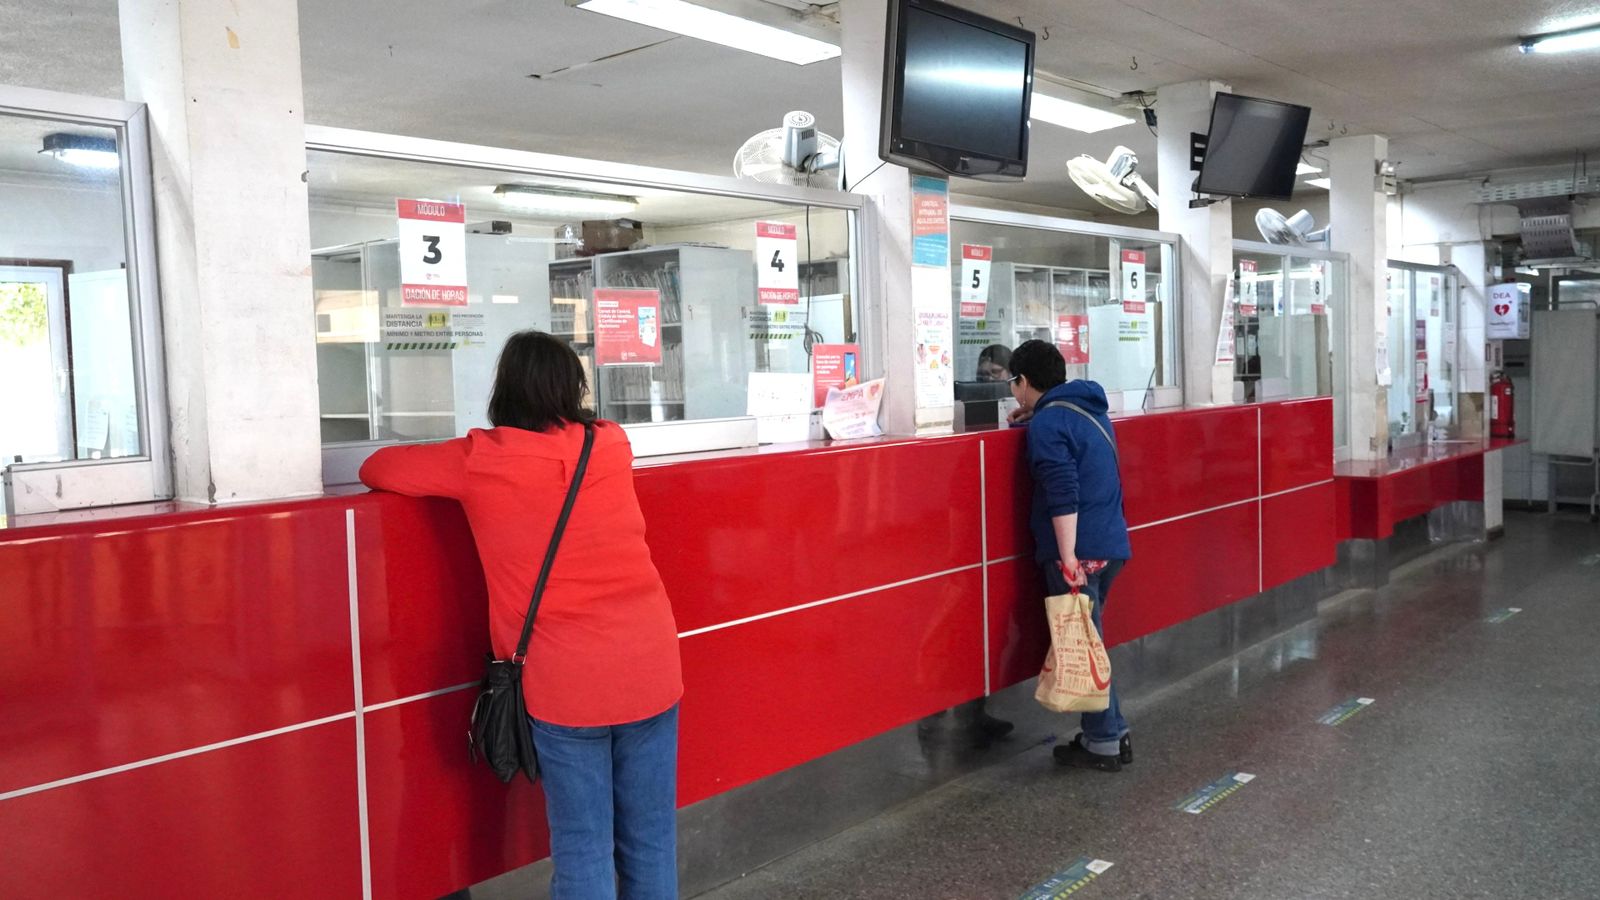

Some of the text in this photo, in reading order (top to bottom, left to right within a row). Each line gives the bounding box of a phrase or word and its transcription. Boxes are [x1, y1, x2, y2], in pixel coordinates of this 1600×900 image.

[417, 203, 445, 216] MÓDULO
[422, 235, 442, 265] 3
[771, 250, 785, 272] 4
[971, 269, 981, 289] 5
[1130, 271, 1138, 289] 6
[1314, 281, 1321, 295] 8
[405, 287, 465, 301] DACIÓN DE HORAS
